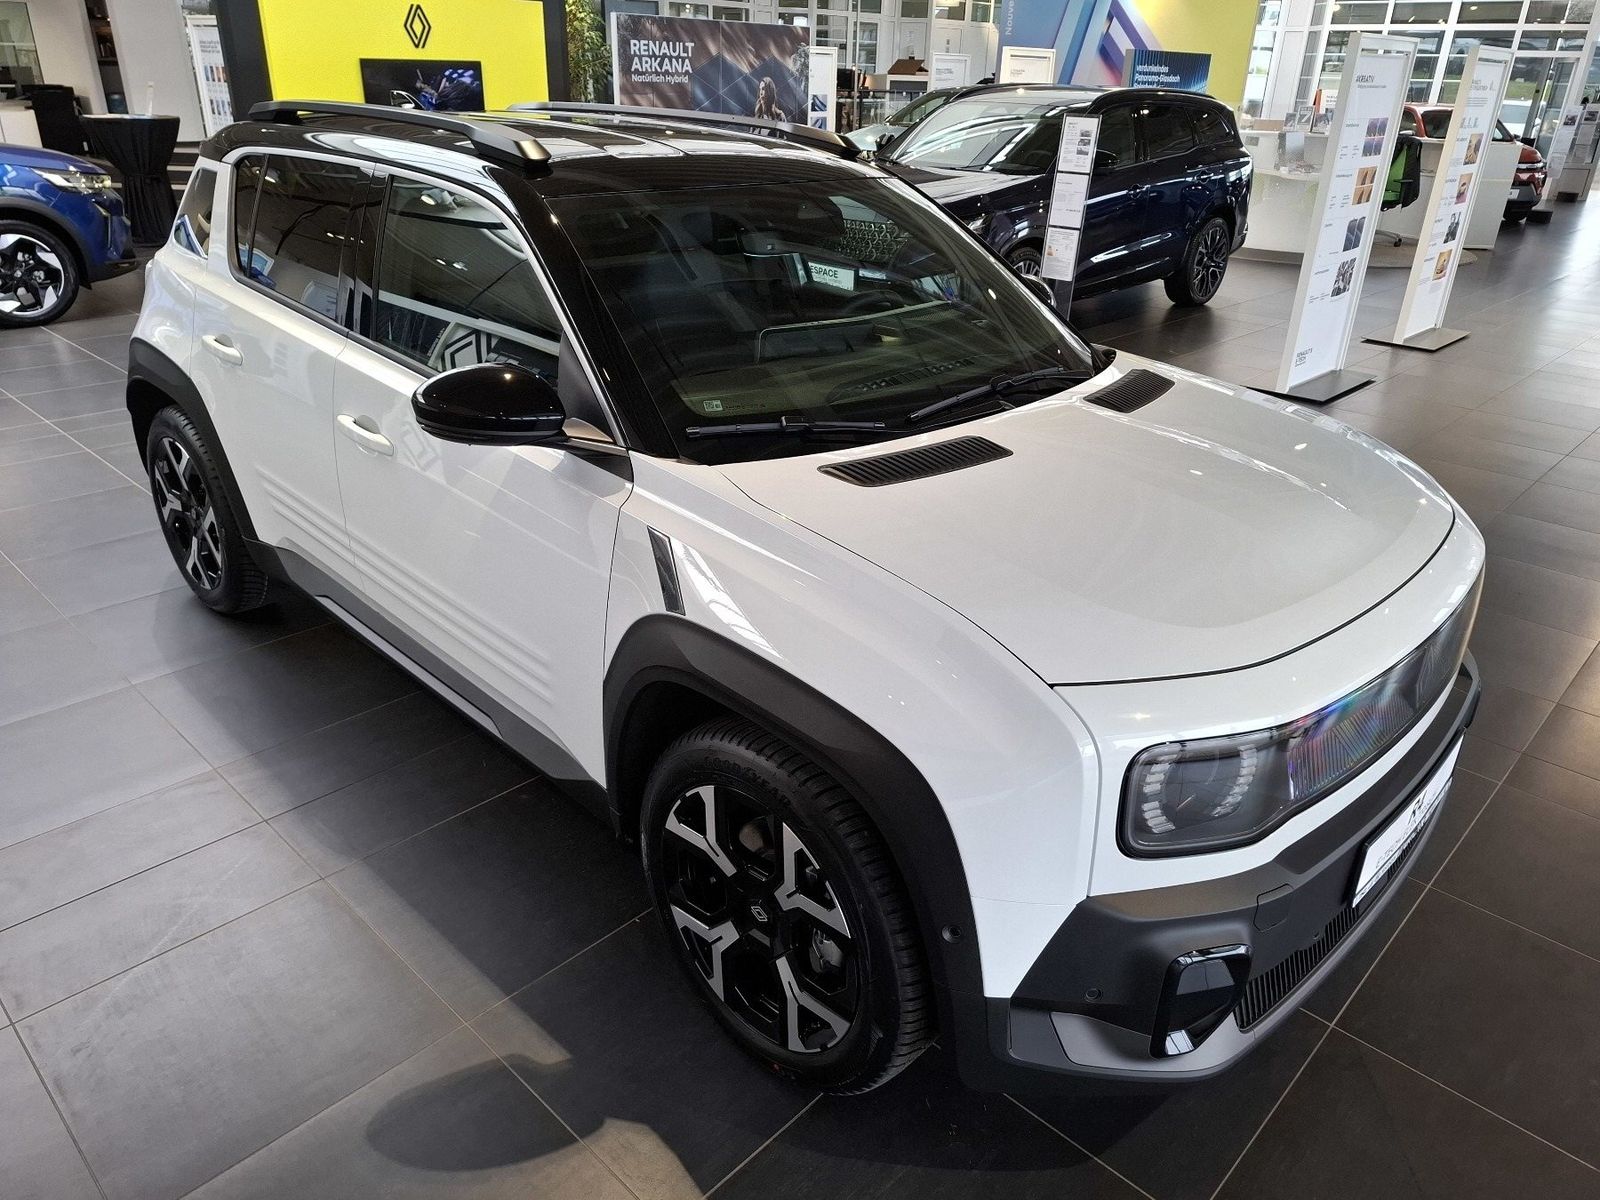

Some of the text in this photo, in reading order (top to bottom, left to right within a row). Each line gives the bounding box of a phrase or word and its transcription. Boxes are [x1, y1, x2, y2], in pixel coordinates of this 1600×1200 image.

[630, 40, 695, 57] RENAULT
[631, 57, 693, 73] ARKANA
[631, 74, 689, 84] Natürlich Hybrid
[1135, 73, 1180, 82] Panorama-Glasdach
[810, 265, 838, 278] ESPACE
